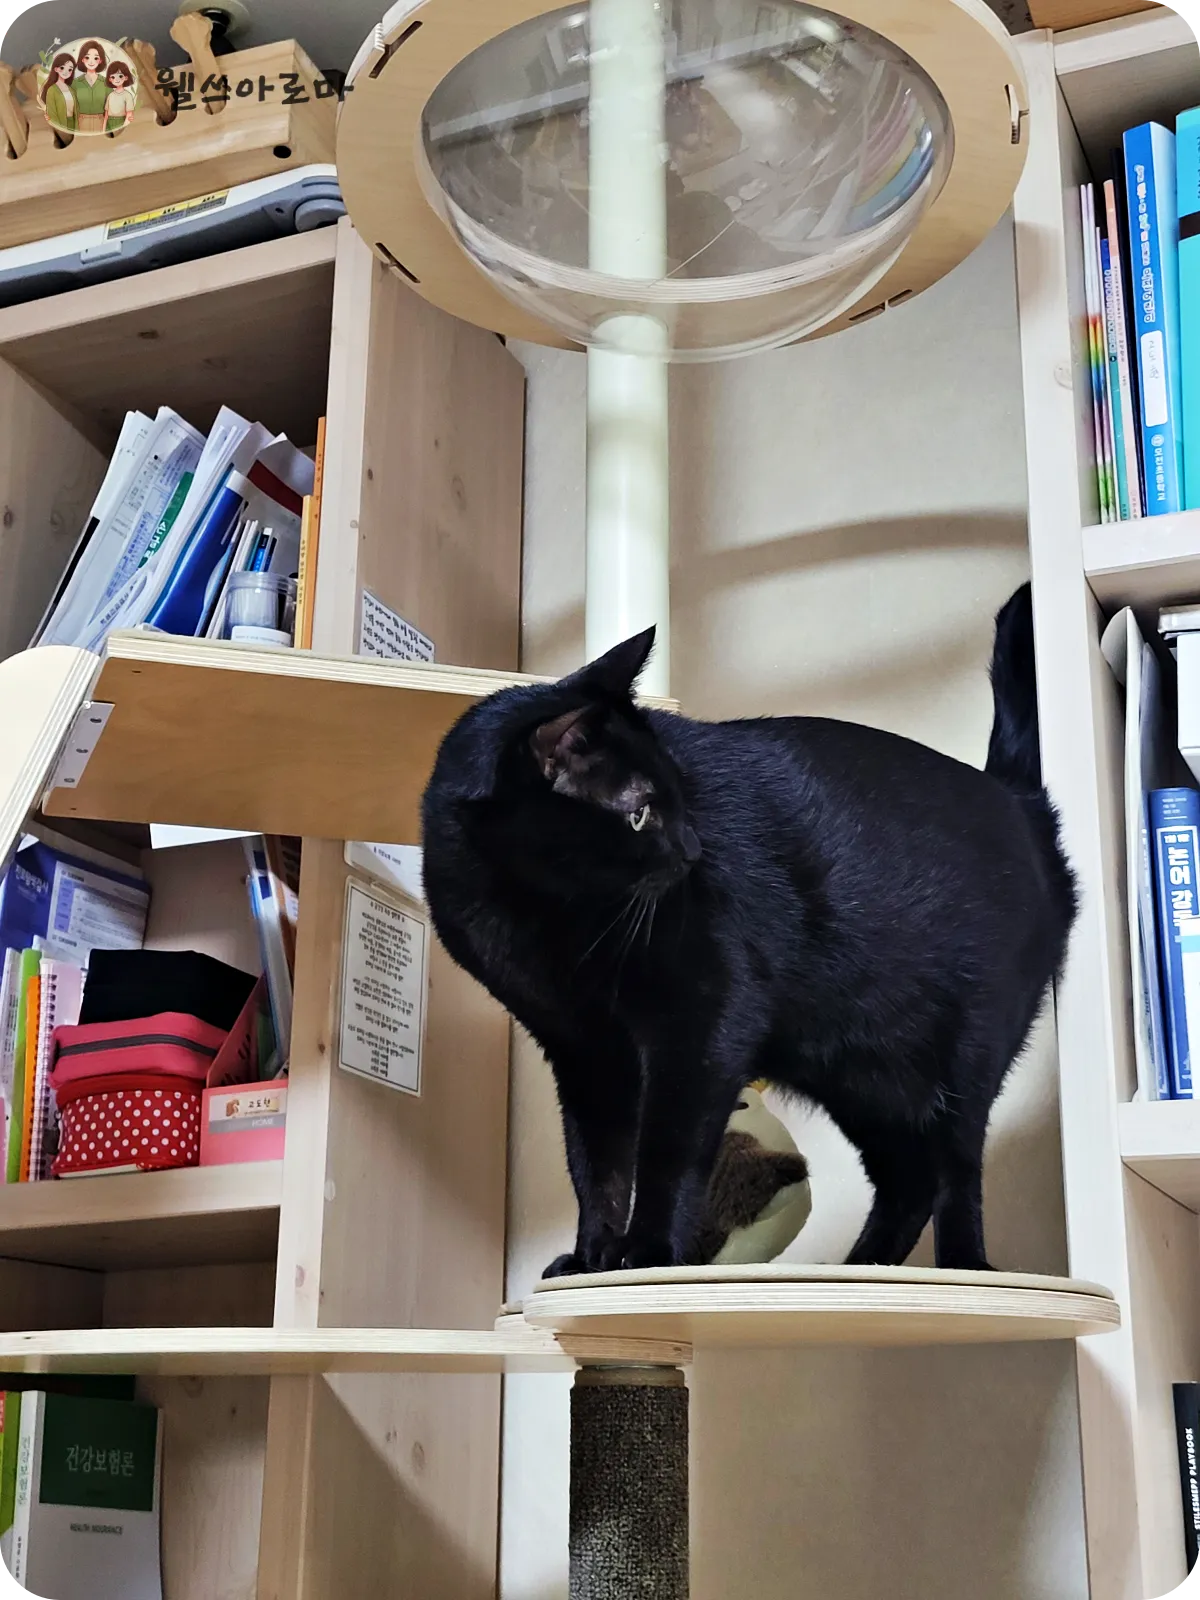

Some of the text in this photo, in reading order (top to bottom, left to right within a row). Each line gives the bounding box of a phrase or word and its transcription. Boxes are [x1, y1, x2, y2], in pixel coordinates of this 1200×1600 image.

[1168, 847, 1191, 885] 논어
[66, 1444, 135, 1476] 건강보험론
[1185, 1427, 1197, 1476] PLAYBOOK
